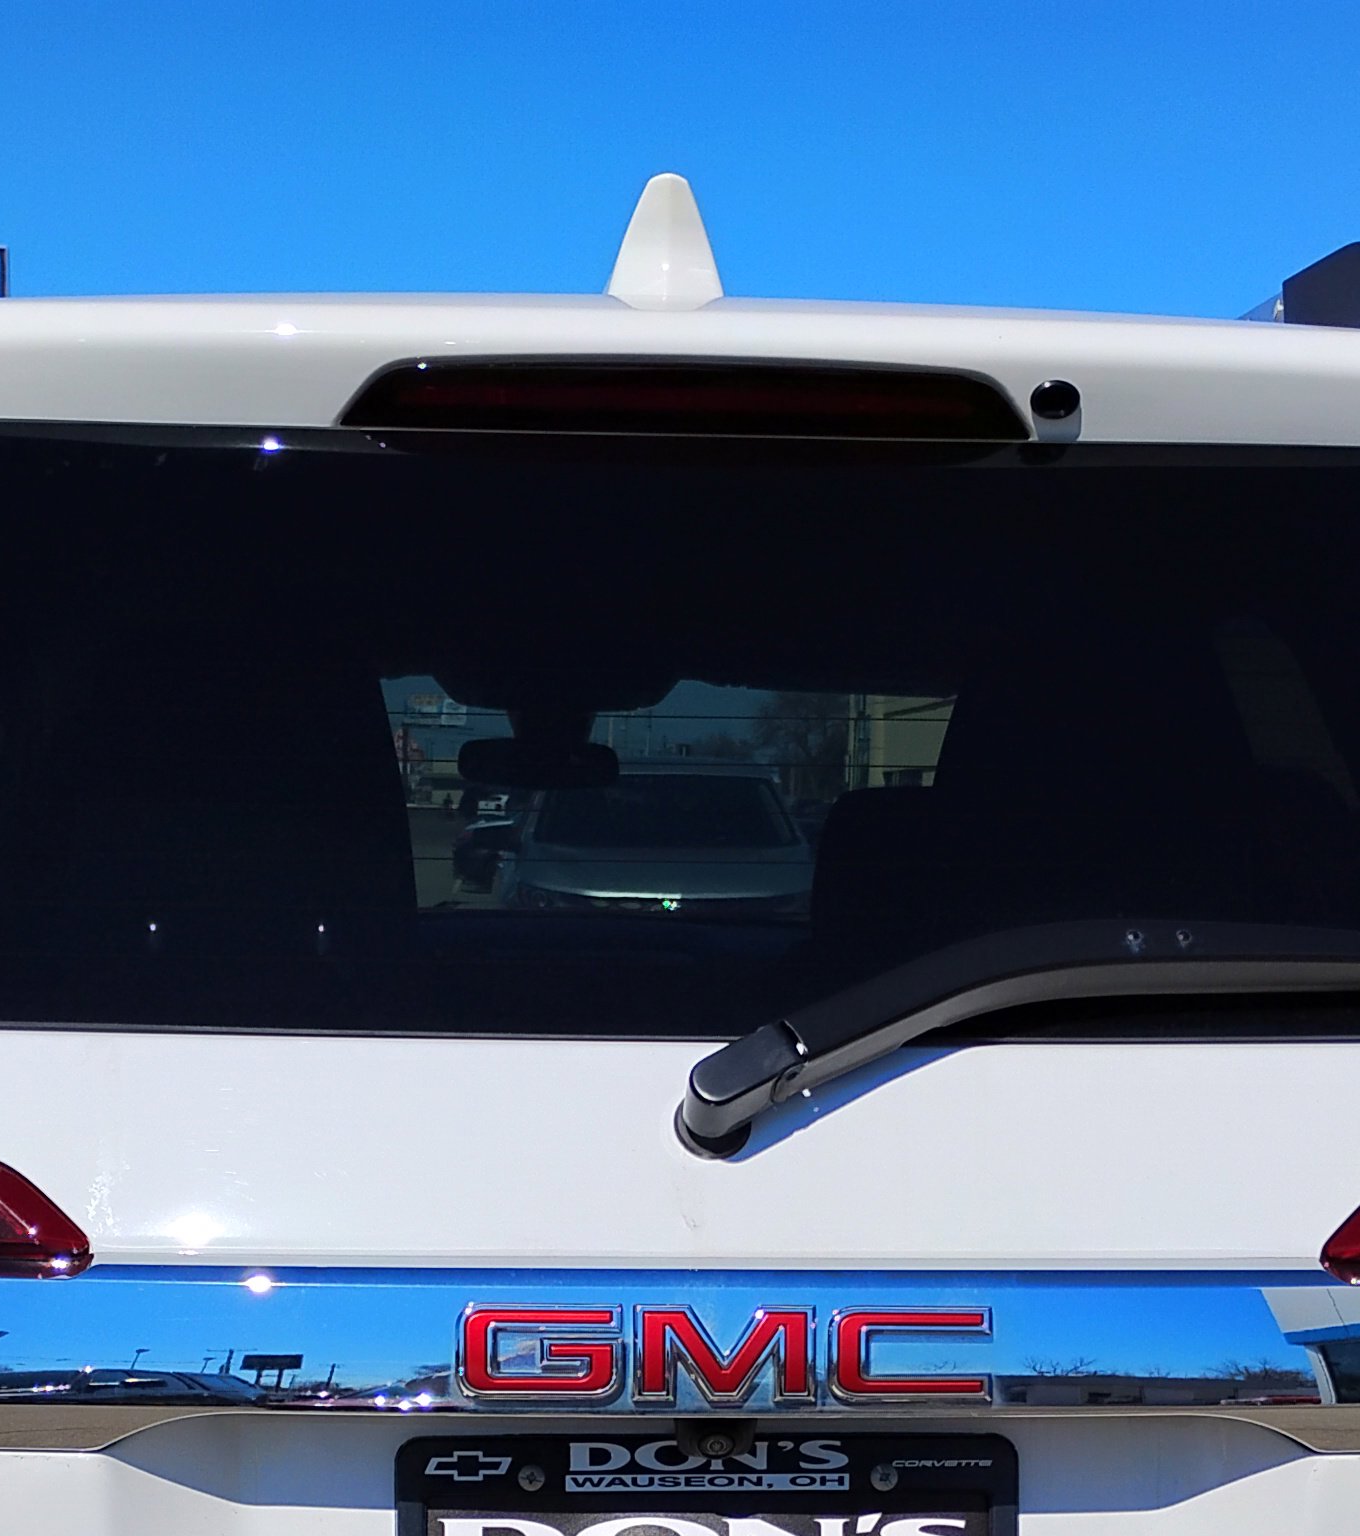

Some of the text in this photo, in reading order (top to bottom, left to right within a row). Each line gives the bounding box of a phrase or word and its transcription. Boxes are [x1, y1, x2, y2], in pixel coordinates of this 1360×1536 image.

[456, 1302, 993, 1402] GMC
[891, 1459, 993, 1468] CORVETTE
[570, 1475, 846, 1490] WAUSEON, OH
